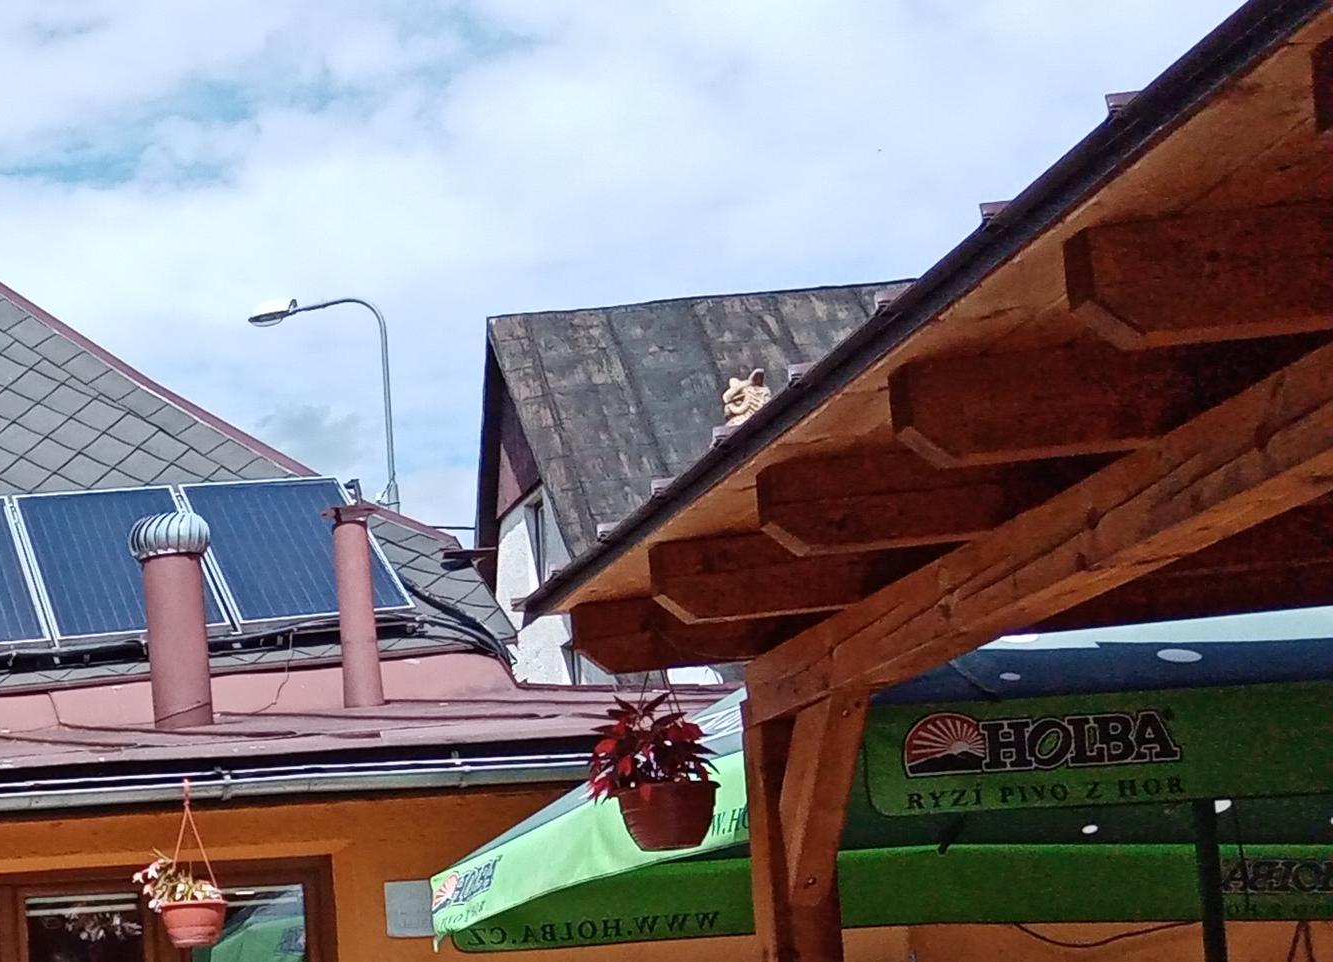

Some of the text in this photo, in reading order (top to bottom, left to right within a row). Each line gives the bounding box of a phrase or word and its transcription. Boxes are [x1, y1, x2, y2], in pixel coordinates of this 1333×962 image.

[979, 711, 1182, 773] HOLBA
[904, 776, 1185, 811] RYZÍ PIVO Z HOR
